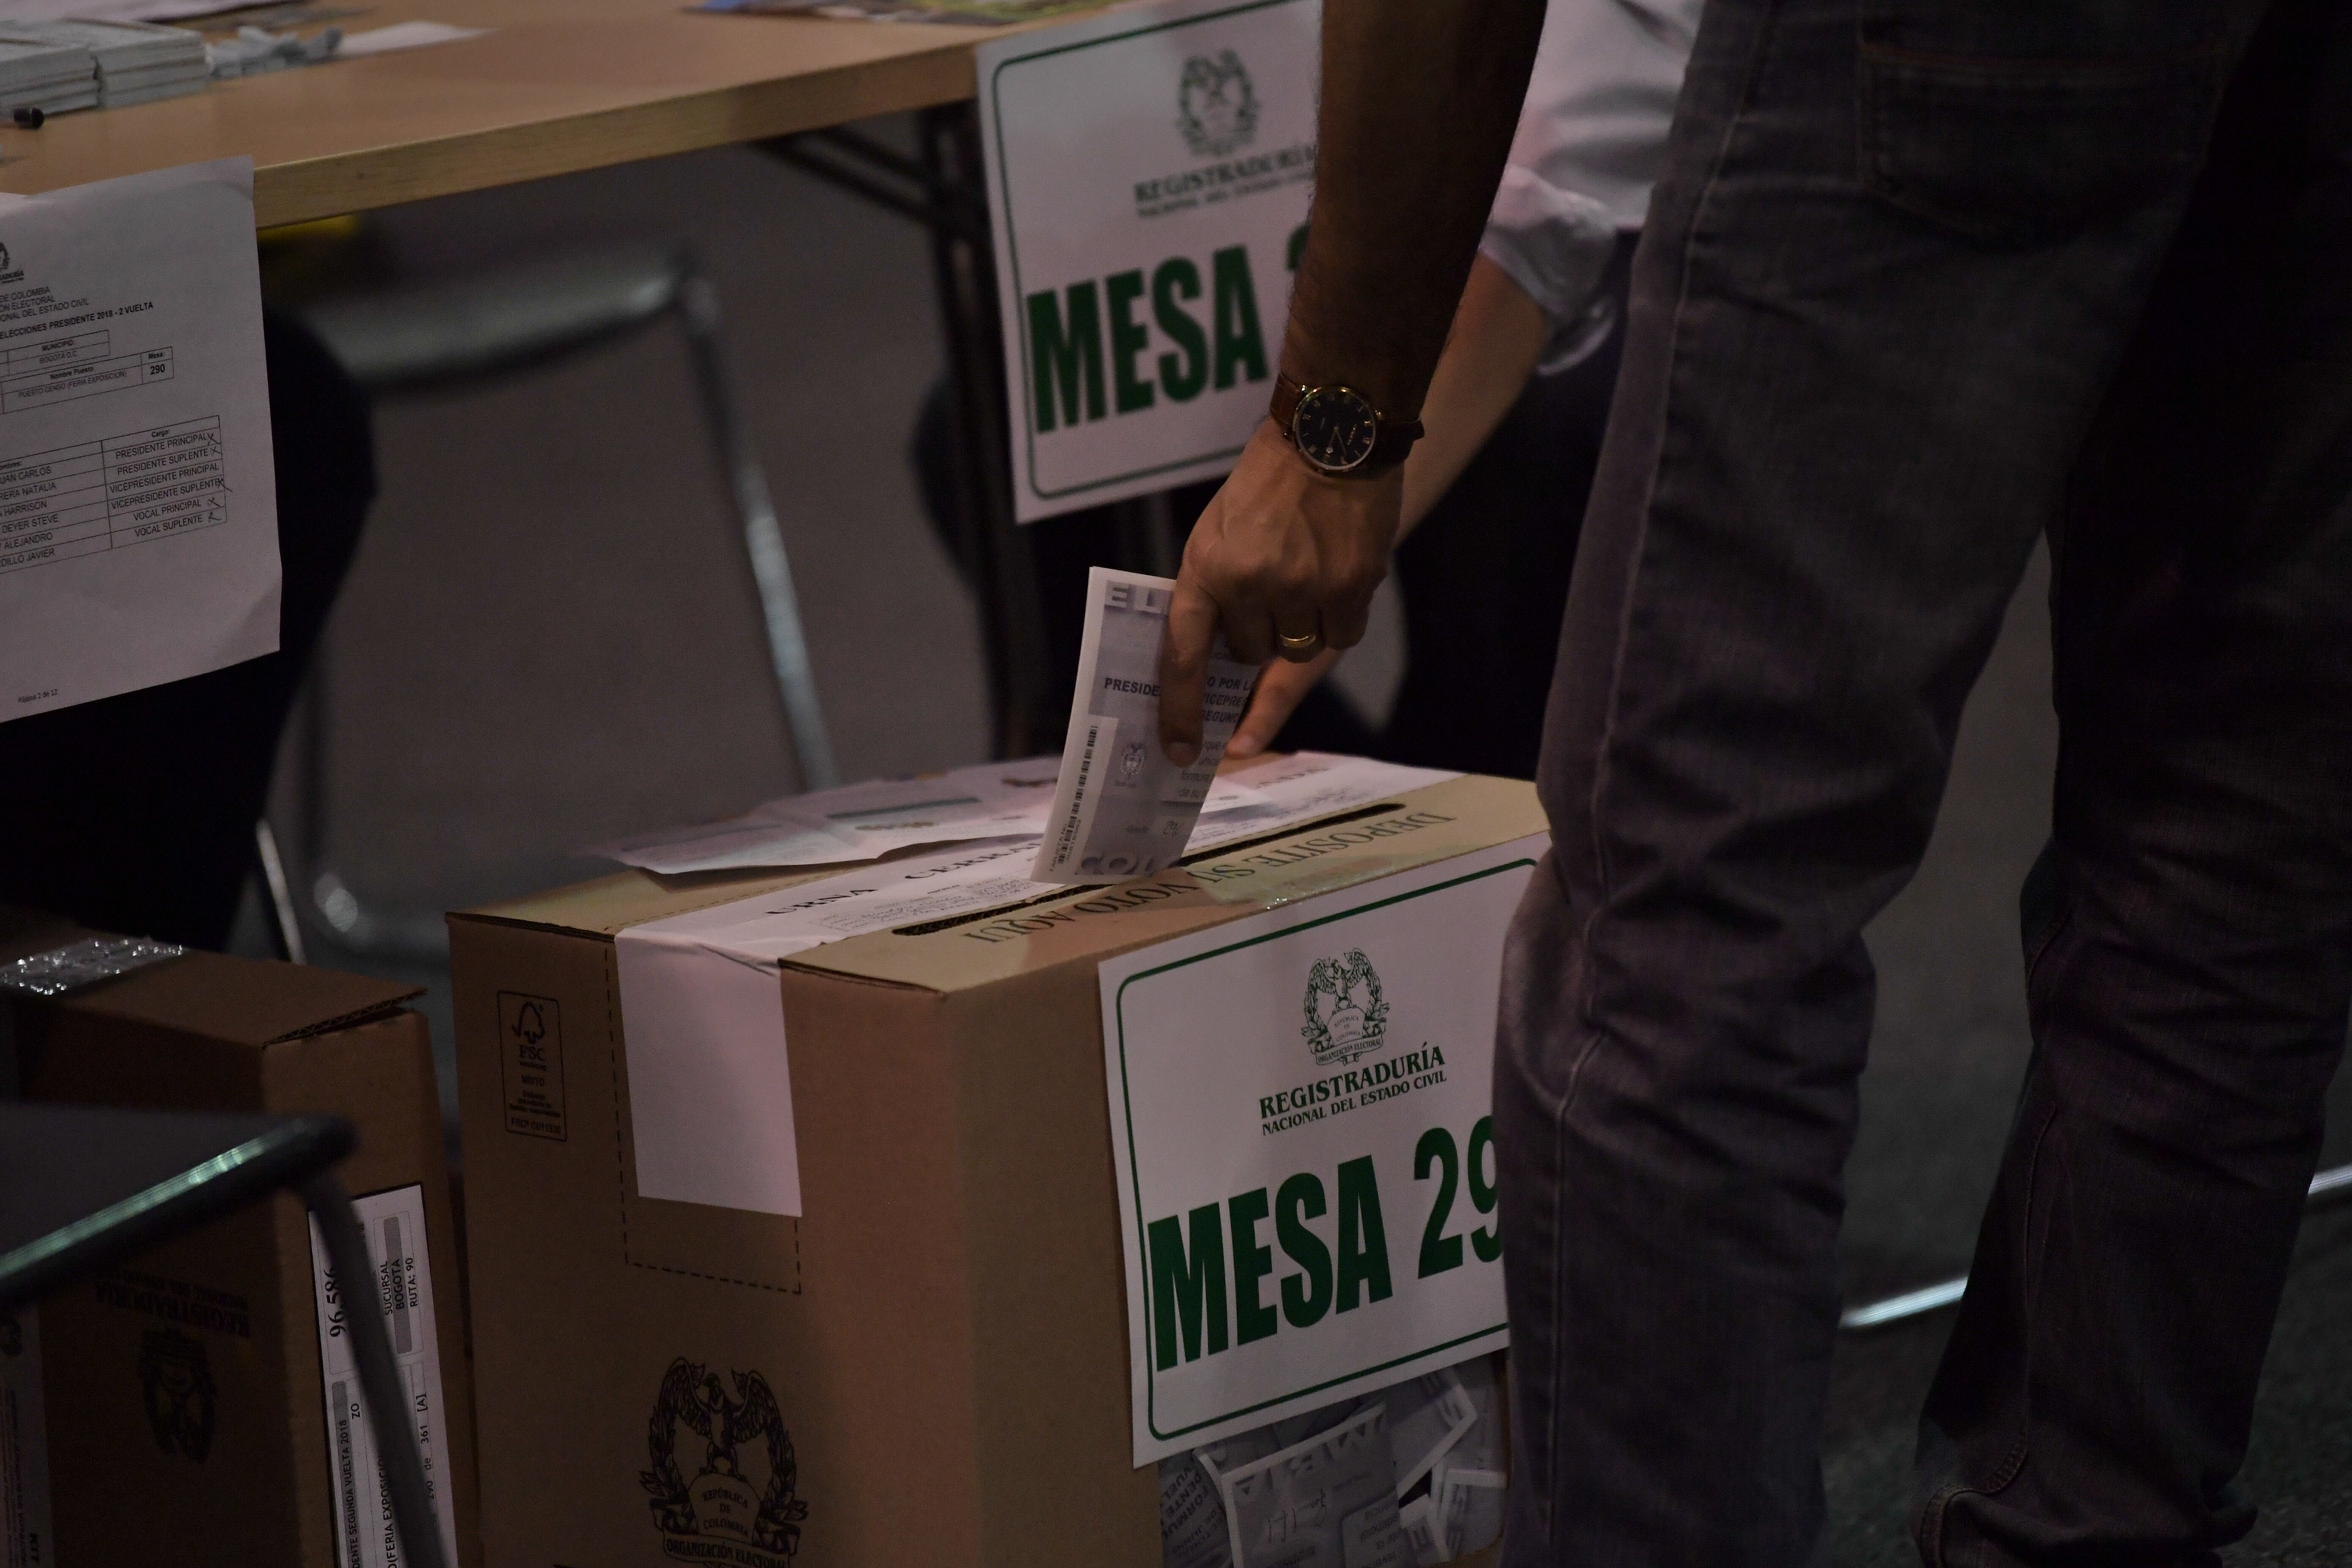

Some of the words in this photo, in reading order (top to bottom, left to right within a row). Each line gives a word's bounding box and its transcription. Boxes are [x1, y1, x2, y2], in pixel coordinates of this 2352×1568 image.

[11, 295, 55, 310] ELECTORAL
[22, 308, 37, 318] DEL
[39, 302, 69, 314] ESTADO
[71, 298, 90, 308] CIVIL
[0, 323, 47, 339] ELECCIONES
[49, 313, 95, 329] PRESIDENTE
[97, 310, 113, 320] 2018
[125, 302, 153, 313] VUELTA
[1027, 245, 1267, 434] MESA
[150, 364, 165, 375] 290
[116, 441, 165, 459] PRESIDENTE
[168, 433, 207, 447] PRINCIPAL
[117, 457, 166, 476] PRESIDENTE
[169, 448, 208, 464] SUPLENTE
[19, 466, 51, 480] CARLOS
[110, 471, 177, 493] VICEPRESIDENTE
[179, 462, 219, 479] PRINCIPAL
[22, 482, 56, 495] NATALIA
[111, 487, 178, 509] VICEPRESIDENTE
[180, 478, 220, 494] SUPLENTE
[4, 501, 47, 517] HARRISON
[133, 508, 161, 521] VOCAL
[162, 499, 201, 514] PRINCIPAL
[32, 514, 58, 527] STEVE
[135, 525, 161, 537] VOCAL
[163, 514, 202, 531] SUPLENTE
[5, 532, 52, 550] ALEJANDRO
[27, 548, 54, 561] JAVIER
[1219, 678, 1241, 690] POR
[1243, 812, 1456, 866] DEPOSITE
[1187, 865, 1255, 883] SU
[1073, 884, 1200, 914] VOTO
[519, 1045, 546, 1062] FSC
[521, 1074, 545, 1087] MIXTO
[1259, 1042, 1446, 1119] REGISTRADURÍA
[1263, 1106, 1327, 1136] NACIONAL
[1331, 1097, 1356, 1115] DEL
[1361, 1083, 1410, 1106] ESTADO
[1414, 1071, 1447, 1092] CIVIL
[406, 1257, 414, 1273] 90
[1148, 1154, 1393, 1372] MESA
[382, 1260, 392, 1315] SUCURSAL
[393, 1258, 405, 1310] BOGOTA
[408, 1276, 419, 1308] RUTA:
[417, 1394, 427, 1413] [A]
[339, 1420, 348, 1442] 2018
[341, 1444, 352, 1486] VUELTA
[424, 1456, 432, 1470] de
[346, 1489, 358, 1535] SEGUNDA
[720, 1503, 731, 1514] DE
[703, 1518, 749, 1537] COLOMBIA
[667, 1538, 733, 1559] ORGANIZACIÓN
